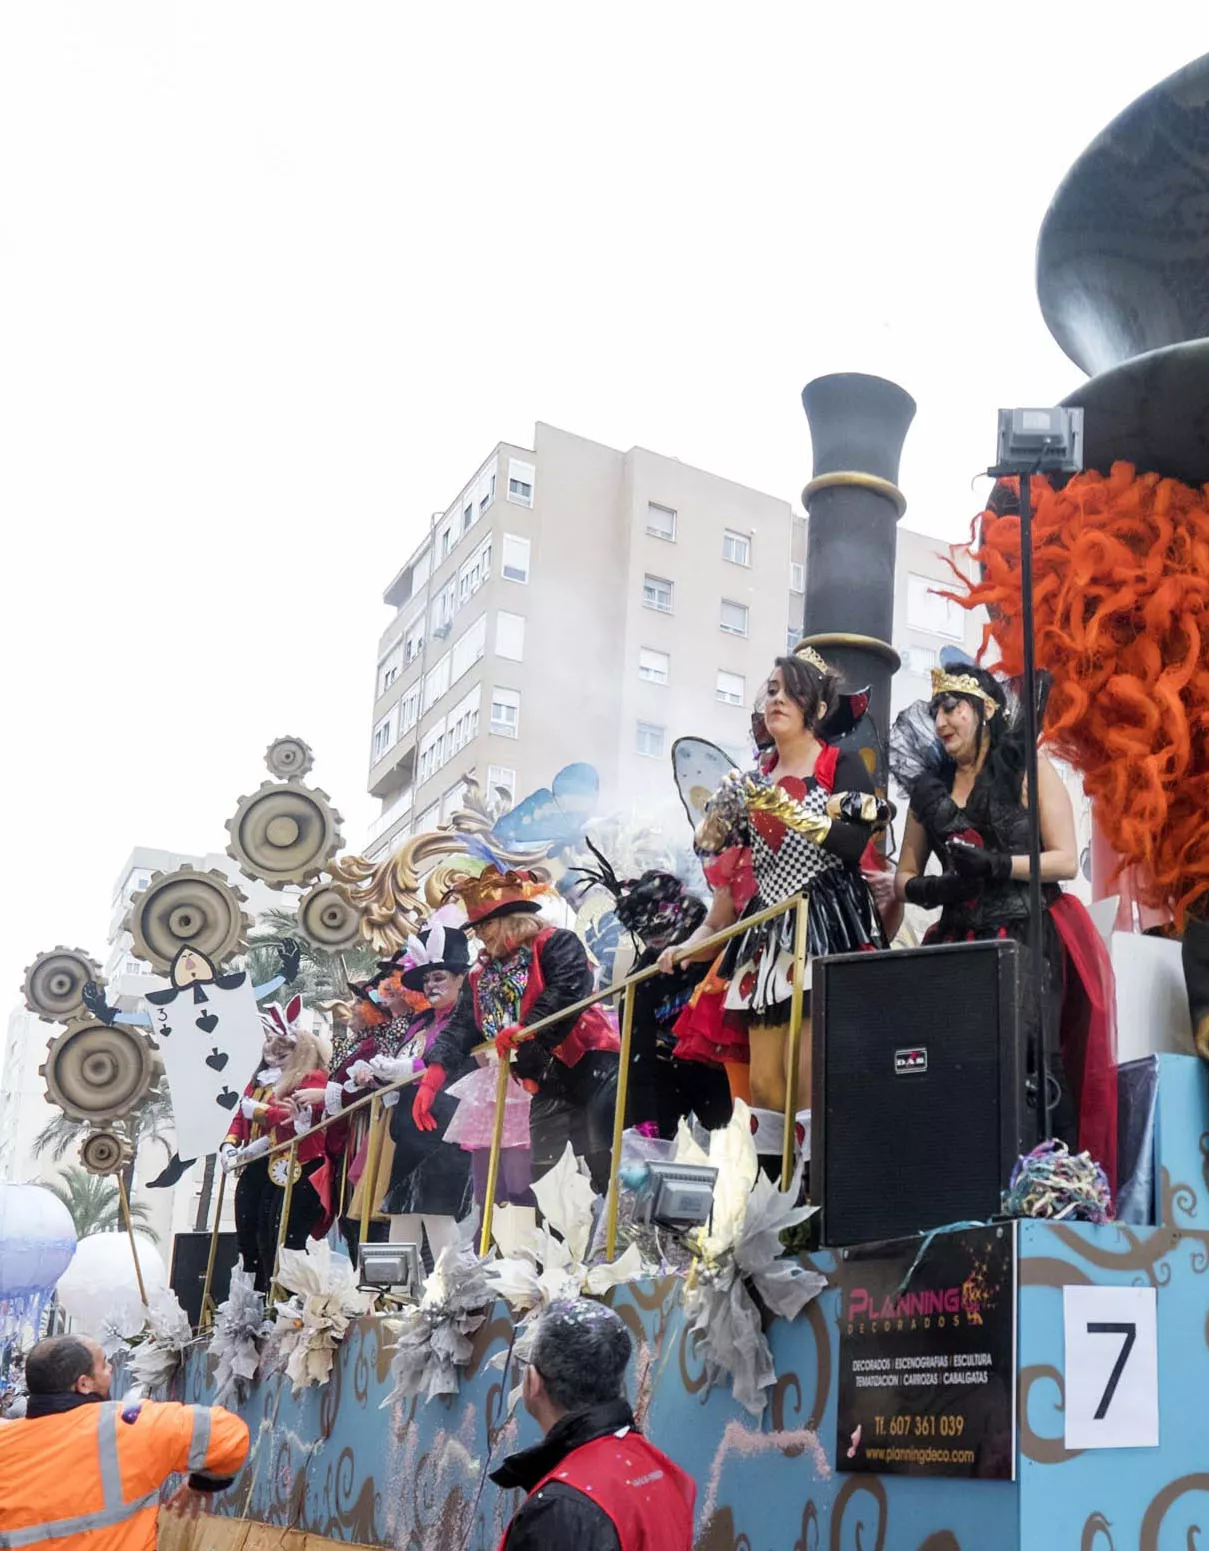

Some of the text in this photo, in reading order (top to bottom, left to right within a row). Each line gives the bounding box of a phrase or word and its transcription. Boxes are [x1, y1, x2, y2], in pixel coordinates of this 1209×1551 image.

[157, 1008, 168, 1022] 3
[849, 1288, 960, 1321] PLANNING
[847, 1315, 960, 1334] DECORADOS
[852, 1359, 891, 1372] DECORADOS
[953, 1353, 992, 1367] ESCULTURA
[1086, 1322, 1136, 1420] 7
[903, 1373, 938, 1386] CARROZAS
[943, 1371, 988, 1384] CABALGATAS
[889, 1415, 912, 1436] 607
[914, 1415, 935, 1436] 361
[940, 1415, 964, 1436] 039
[865, 1446, 975, 1464] www.planningdeco.com
